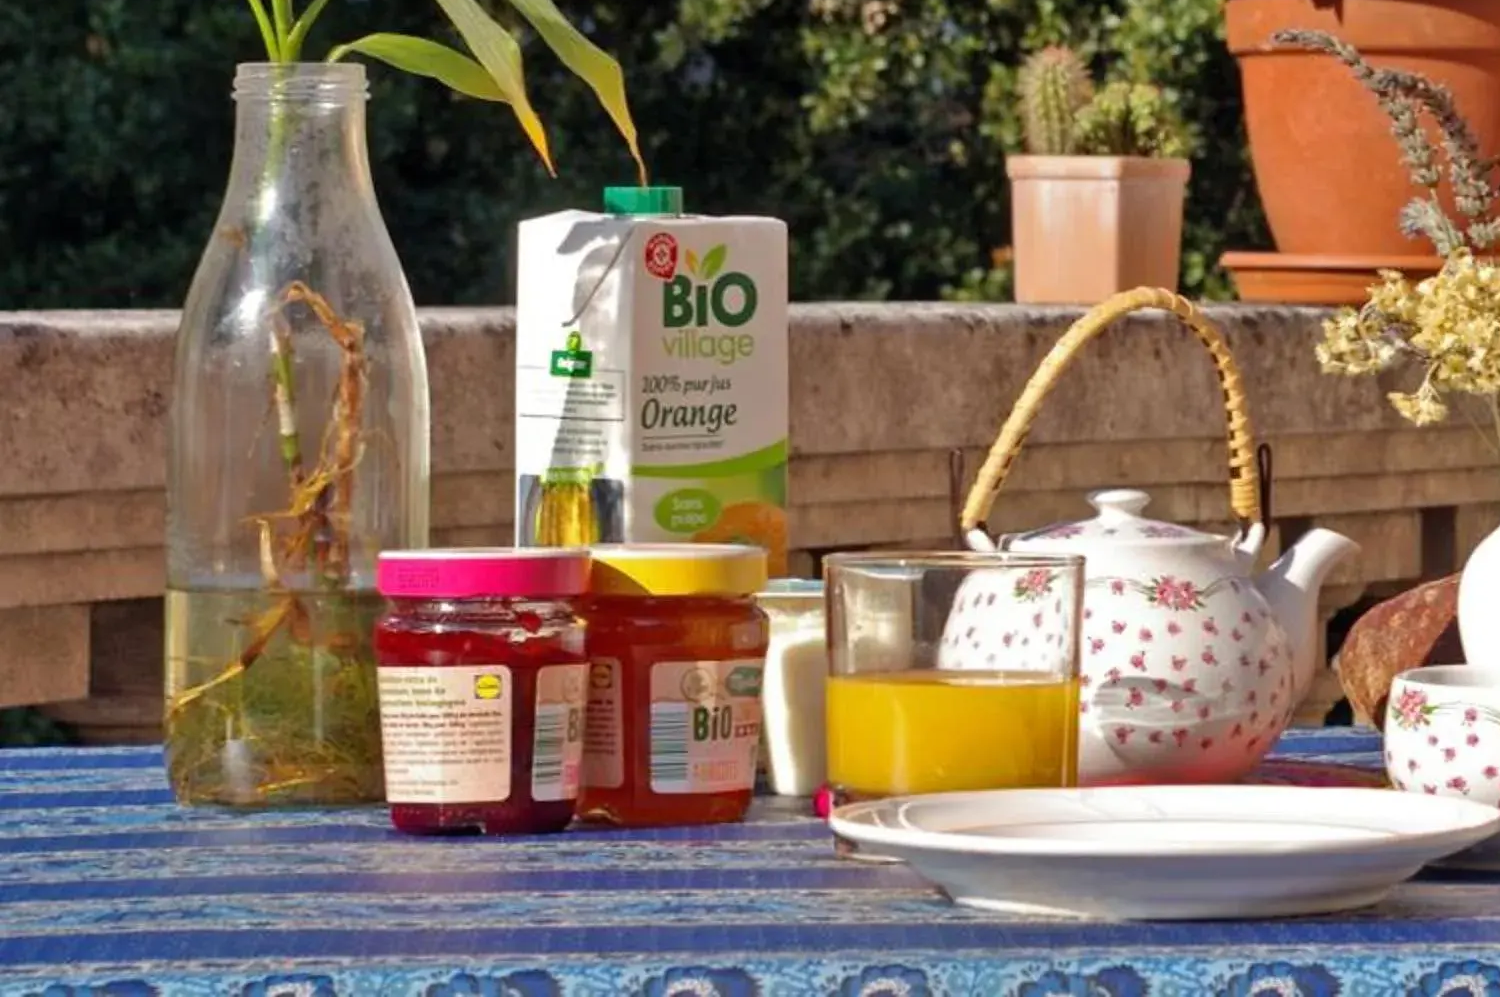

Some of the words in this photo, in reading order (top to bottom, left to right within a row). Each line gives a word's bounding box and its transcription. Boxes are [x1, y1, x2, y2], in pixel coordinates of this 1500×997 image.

[661, 328, 754, 365] village
[641, 375, 681, 394] 100%
[682, 379, 709, 395] pur
[709, 373, 732, 395] jus
[641, 397, 738, 433] Orange
